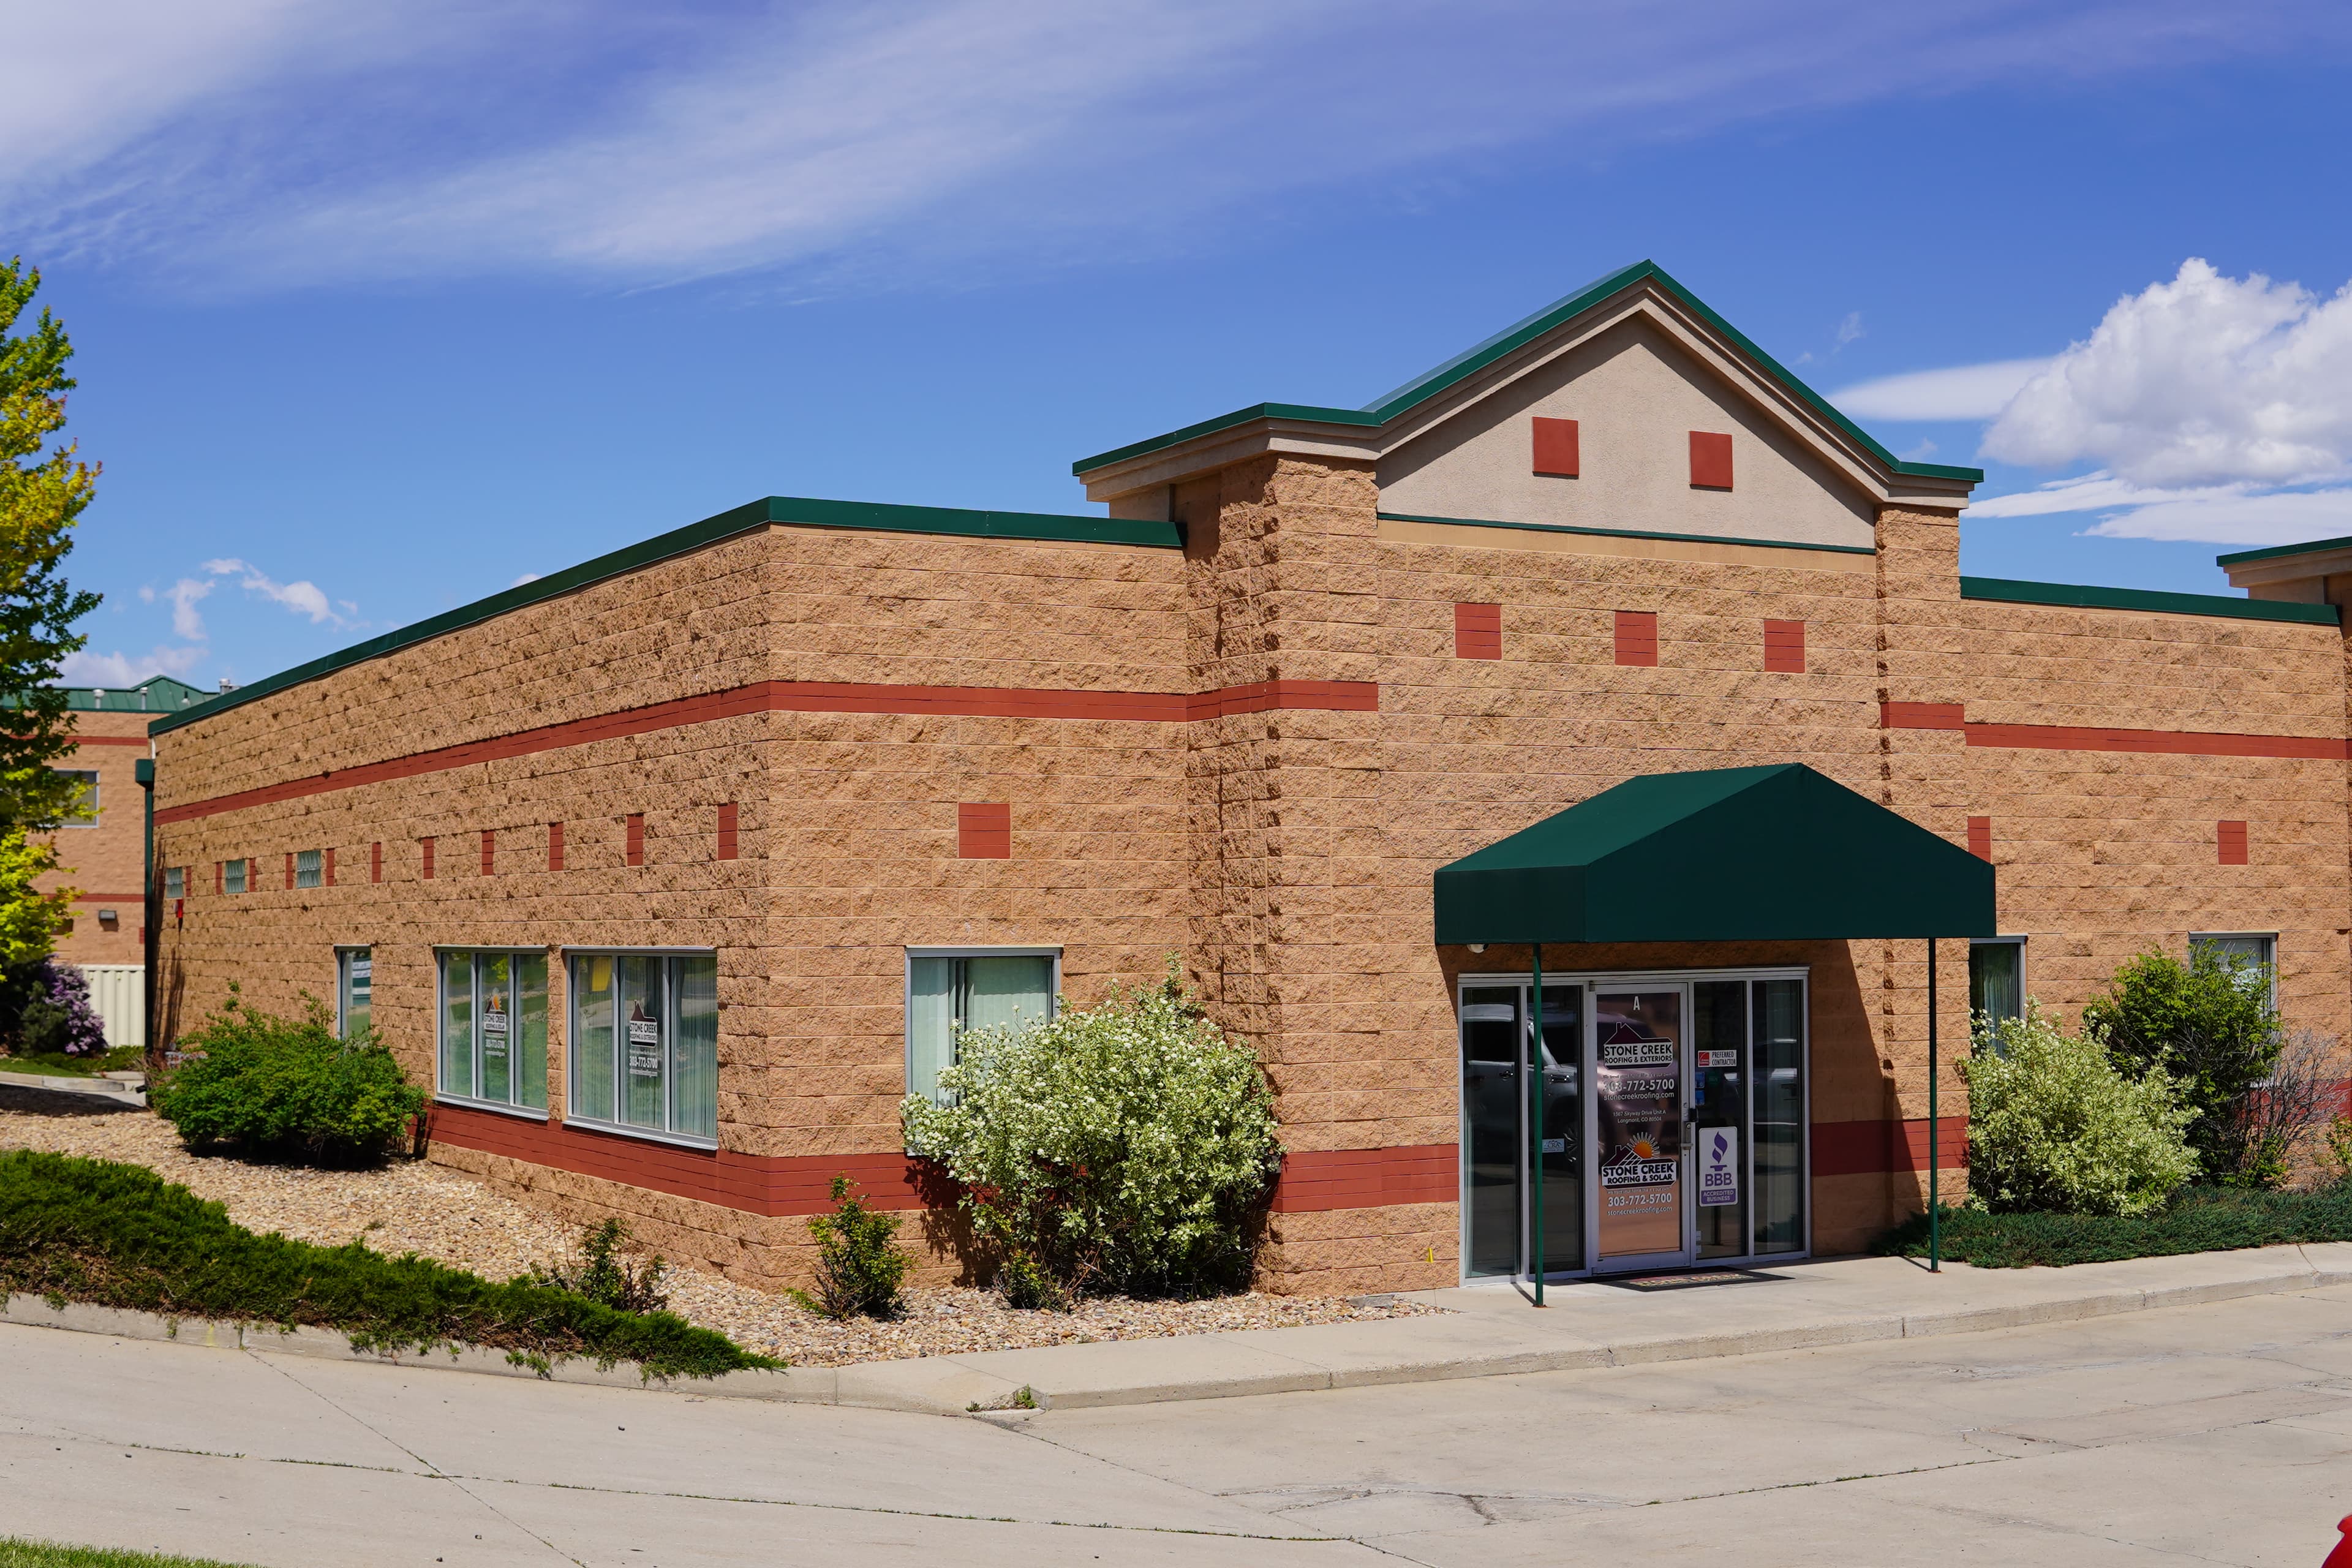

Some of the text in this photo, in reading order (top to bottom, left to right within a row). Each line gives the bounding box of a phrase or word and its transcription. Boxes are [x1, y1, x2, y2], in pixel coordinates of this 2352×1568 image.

[1633, 996, 1640, 1011] A
[630, 1023, 657, 1033] STONE CREEK
[1605, 1044, 1672, 1056] STONE CREEK
[630, 1056, 657, 1069] 303-772-5700
[1603, 1079, 1675, 1091] 303-772-5700
[1604, 1092, 1675, 1101] stonecreekroofing.com
[1603, 1163, 1674, 1177] STONE CREEK
[1705, 1172, 1732, 1187] BBB
[1608, 1193, 1672, 1207] 303-772-5700
[1607, 1206, 1672, 1216] stonecreekroofing.com
